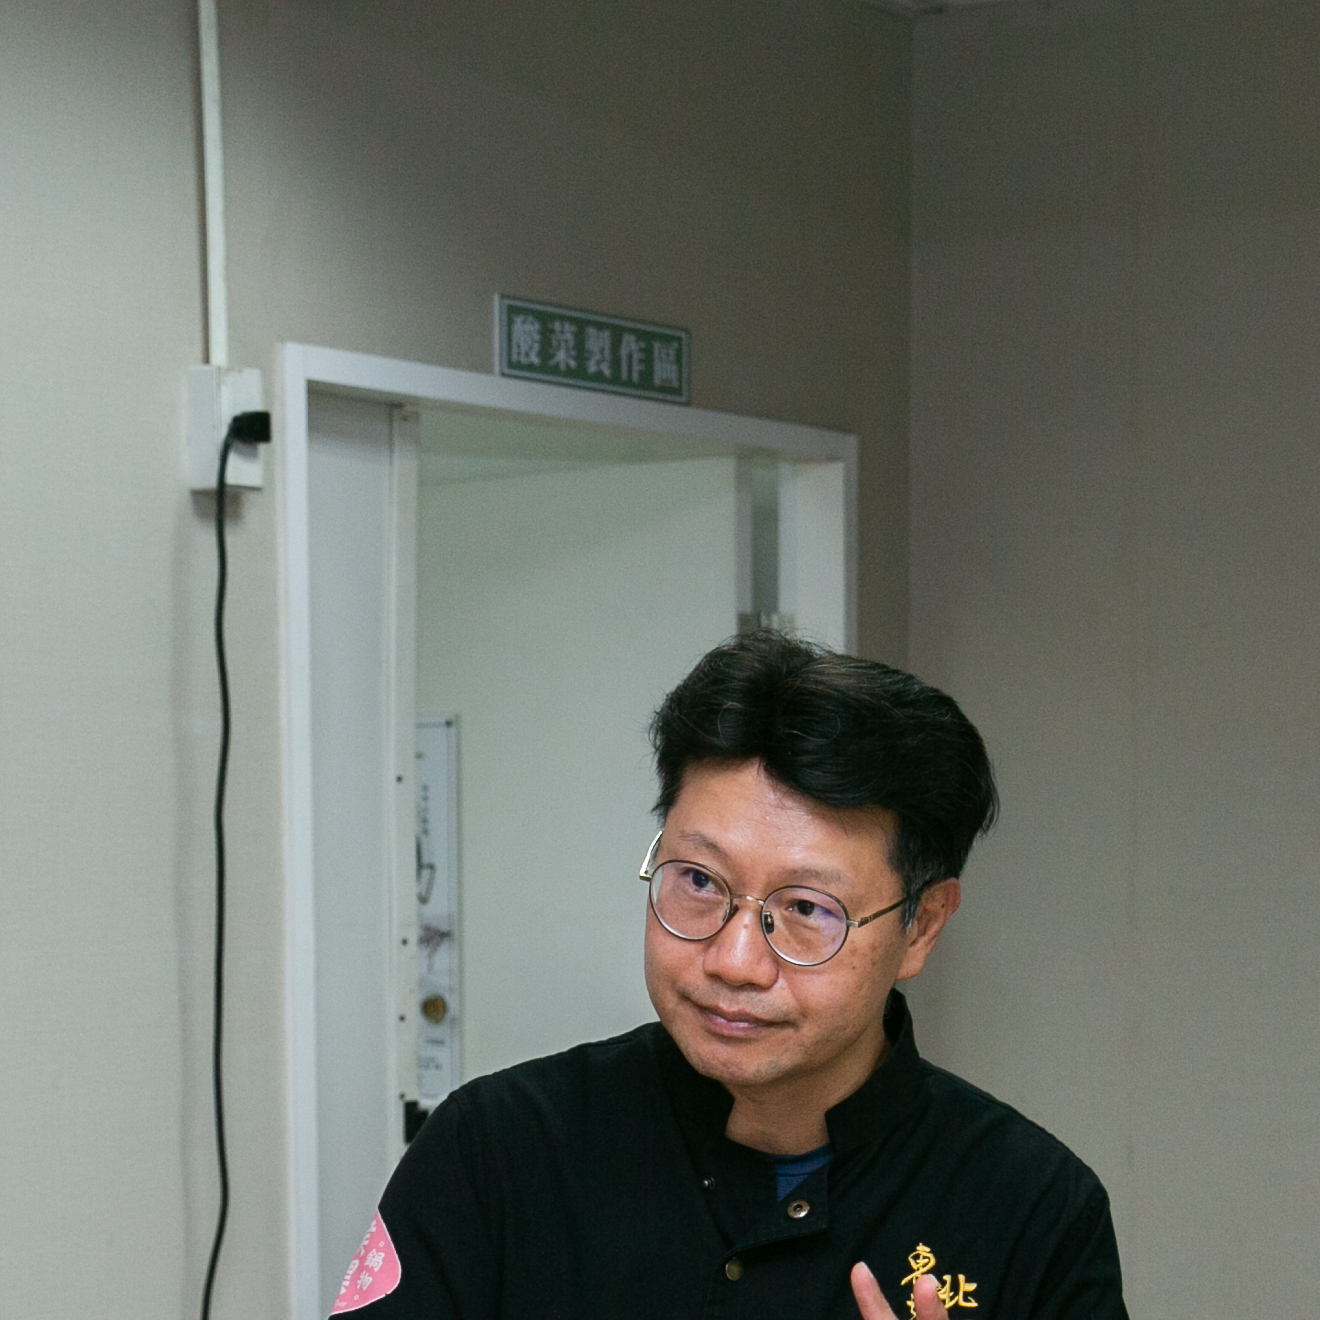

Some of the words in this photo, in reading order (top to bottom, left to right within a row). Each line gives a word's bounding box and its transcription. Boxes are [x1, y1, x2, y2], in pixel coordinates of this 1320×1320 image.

[511, 315, 679, 388] 酸菜製作區
